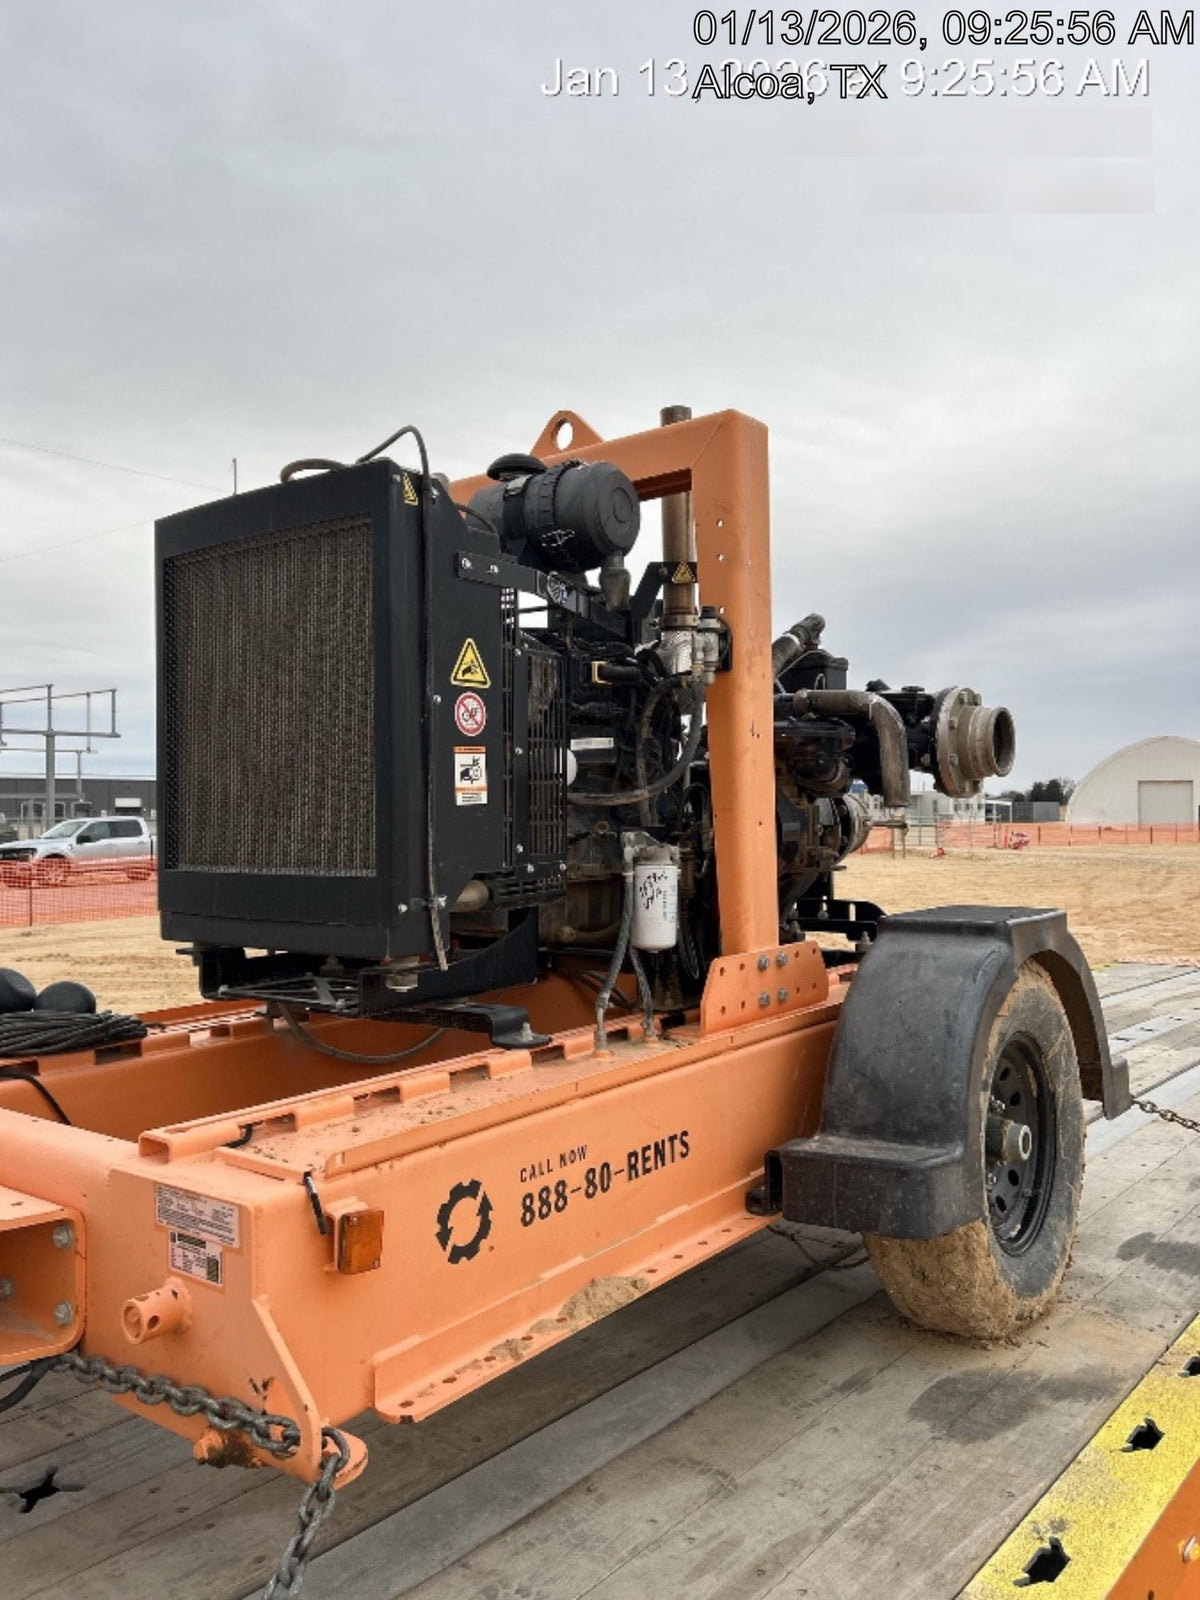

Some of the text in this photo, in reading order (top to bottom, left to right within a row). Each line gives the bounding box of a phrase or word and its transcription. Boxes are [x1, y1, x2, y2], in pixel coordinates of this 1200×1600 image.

[520, 1144, 588, 1183] CALL NOW
[520, 1130, 691, 1228] 888-80-RENTS
